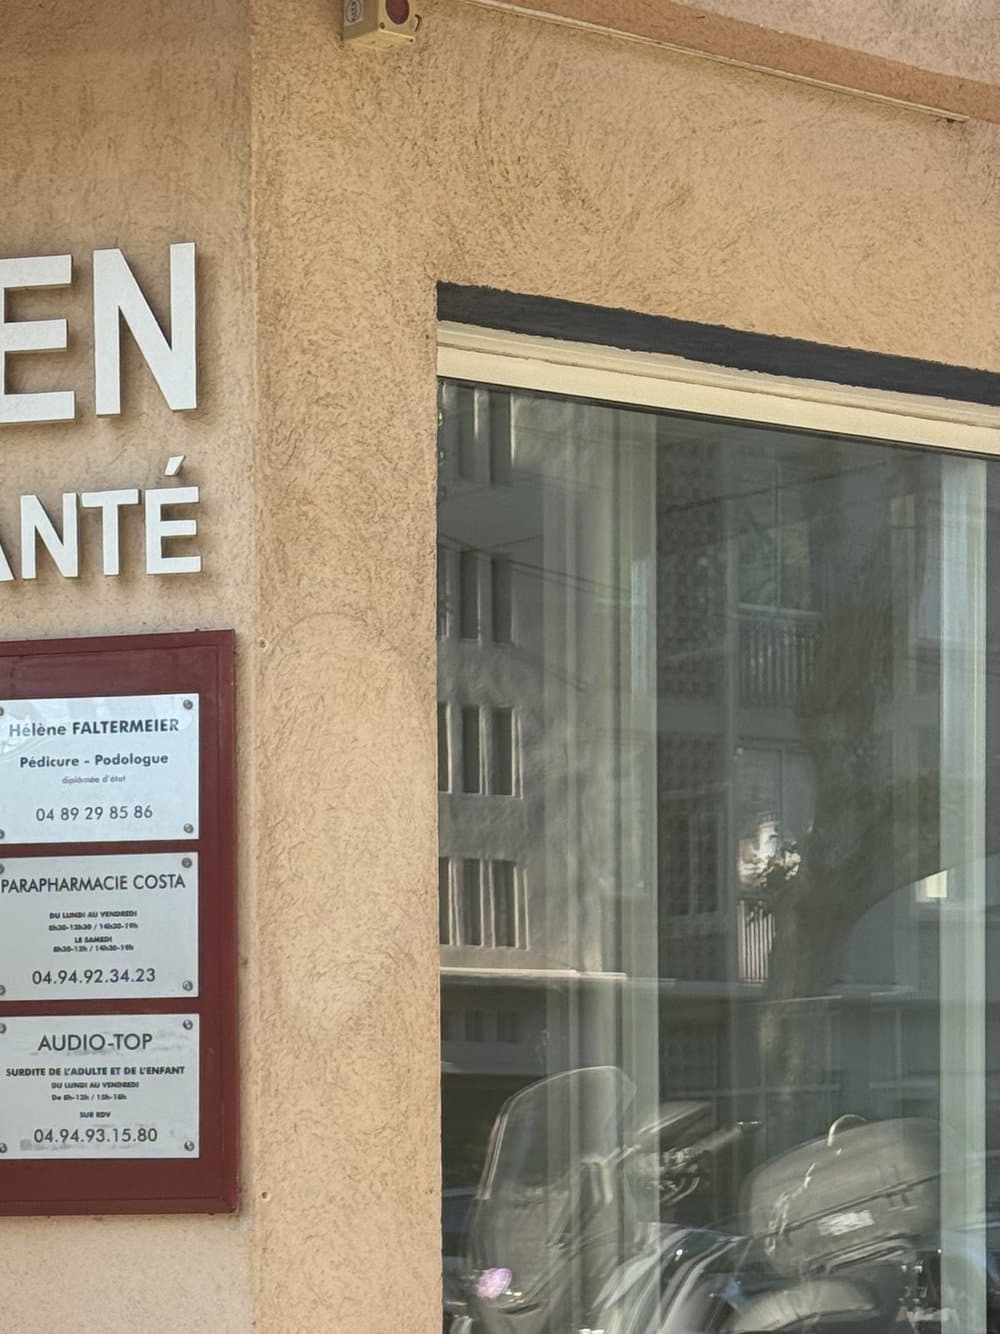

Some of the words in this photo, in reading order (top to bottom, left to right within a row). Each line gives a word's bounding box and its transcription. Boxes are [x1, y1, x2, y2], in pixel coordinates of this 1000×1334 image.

[9, 722, 66, 737] Hélène
[72, 719, 179, 734] FALTERMEIER
[20, 756, 79, 768] Pédicure
[95, 753, 168, 766] Podologue
[36, 808, 54, 821] 04
[61, 807, 79, 821] 89
[85, 807, 103, 820] 29
[110, 806, 128, 819] 85
[134, 805, 153, 818] 86
[1, 875, 128, 893] PARAPHARMACIE
[133, 874, 185, 889] COSTA
[32, 968, 155, 984] 04.94.92.34.23
[38, 1033, 153, 1051] AUDIO-TOP
[6, 1068, 45, 1077] SURDITE
[49, 1067, 61, 1076] DE
[64, 1066, 107, 1076] L'ADULTE
[110, 1066, 120, 1075] ET
[124, 1066, 136, 1075] DE
[140, 1065, 185, 1075] L'ENFANT
[34, 1128, 158, 1144] 04.94.93.15.80
